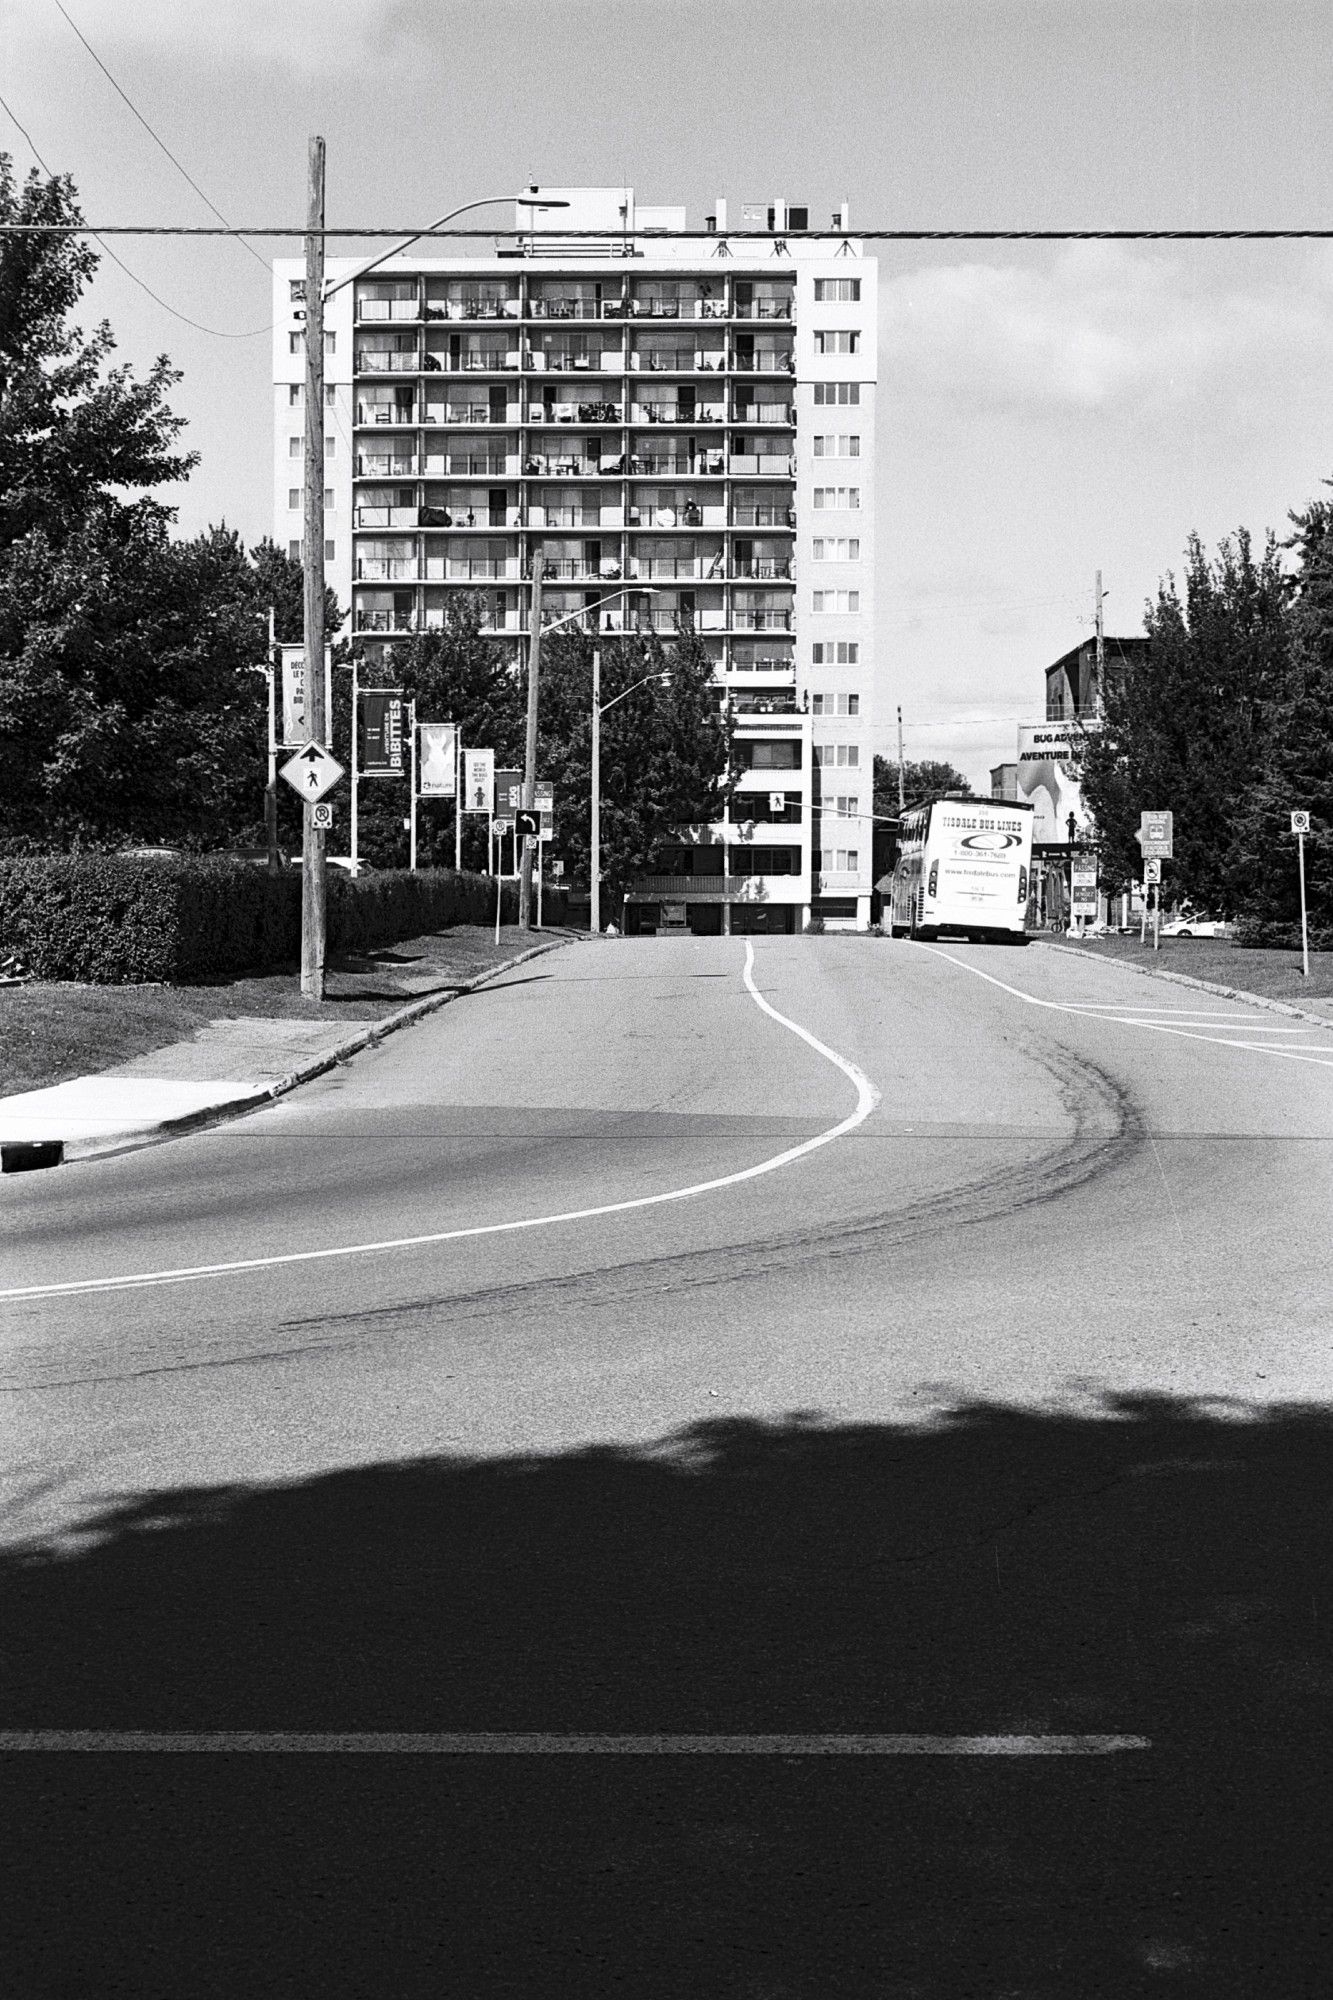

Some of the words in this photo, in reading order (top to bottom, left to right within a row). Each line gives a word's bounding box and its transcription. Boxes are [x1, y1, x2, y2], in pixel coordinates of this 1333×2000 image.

[1034, 734, 1053, 743] BUG
[1020, 751, 1069, 761] AVENTURE
[943, 816, 977, 829] TISDALE
[979, 819, 994, 830] BUS
[997, 820, 1022, 832] LINES
